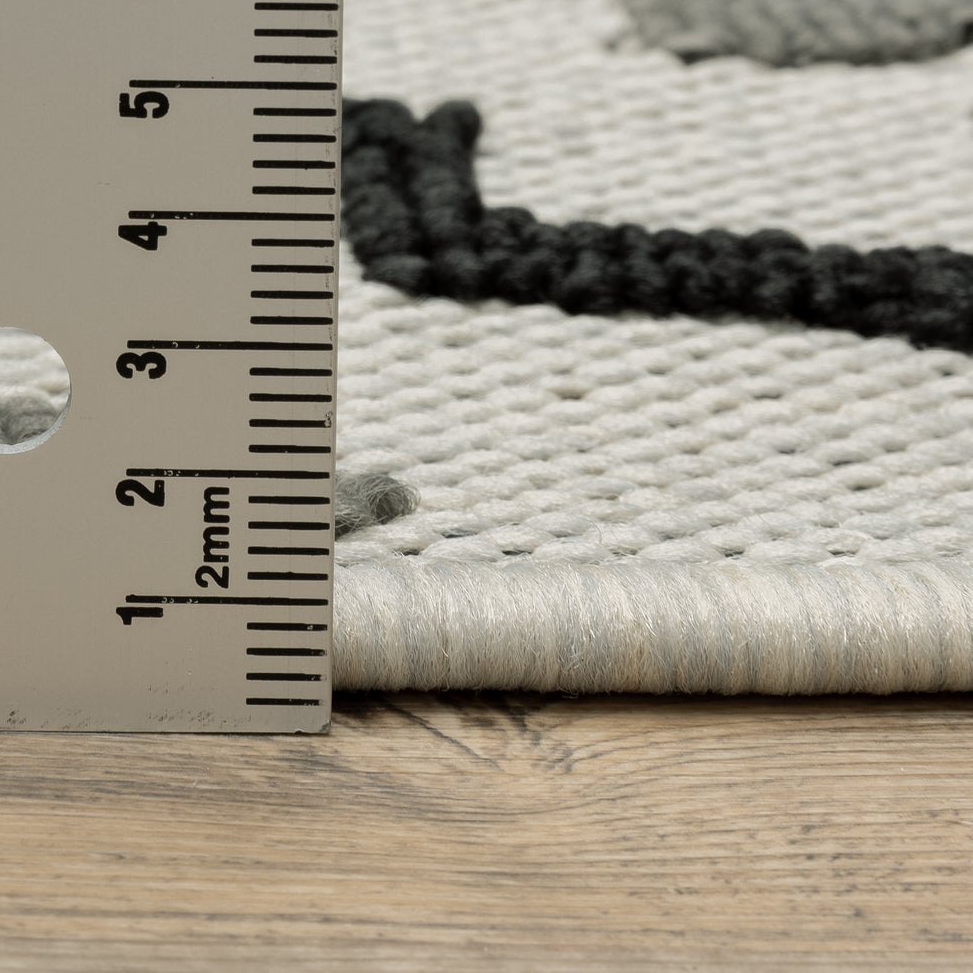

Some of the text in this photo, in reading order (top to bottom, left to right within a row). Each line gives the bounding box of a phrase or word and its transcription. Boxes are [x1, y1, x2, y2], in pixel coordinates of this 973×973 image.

[118, 90, 170, 119] 5
[117, 220, 168, 251] 4
[115, 351, 167, 380] 3
[115, 478, 166, 508] 2
[194, 485, 231, 589] 2mm
[115, 606, 164, 626] 1
